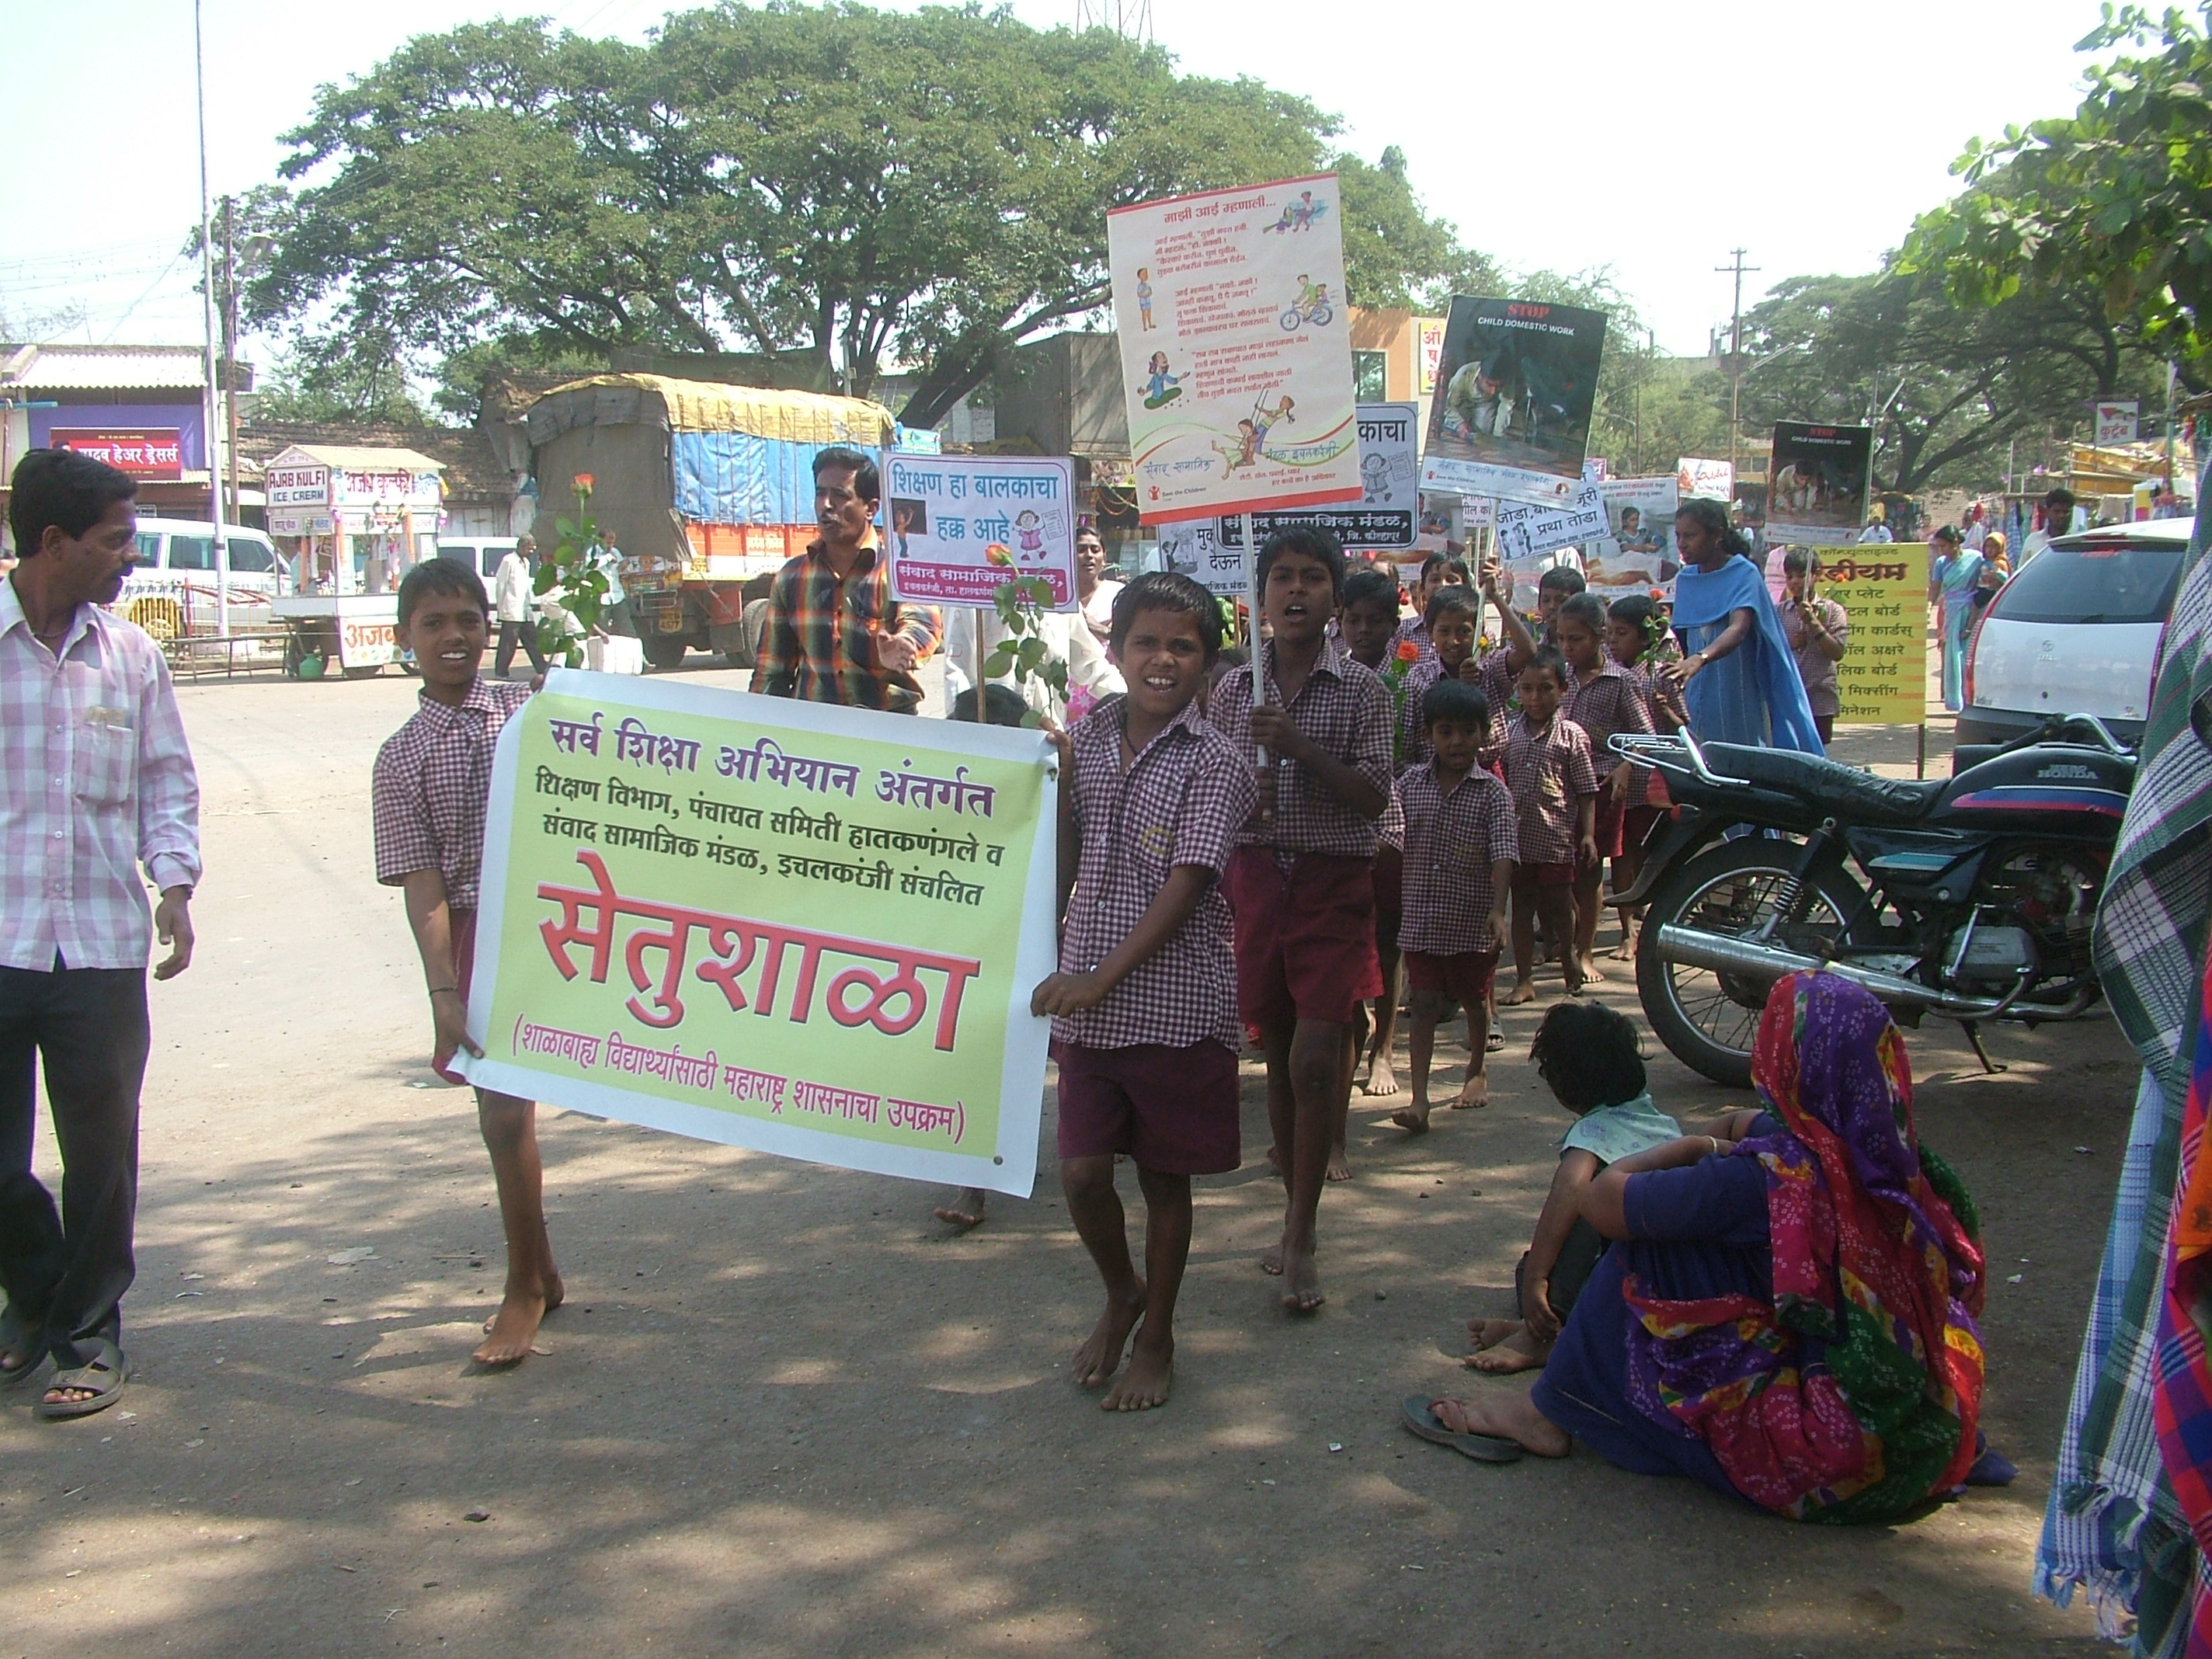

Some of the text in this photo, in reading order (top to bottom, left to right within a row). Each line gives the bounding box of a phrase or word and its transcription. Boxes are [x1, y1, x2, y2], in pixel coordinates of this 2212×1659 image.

[1164, 207, 1191, 223] माझी
[1196, 202, 1219, 217] आई
[1507, 304, 1550, 318] STOP
[1478, 317, 1575, 336] CHILD DOMESTIC WORK
[1358, 419, 1407, 443] काचा
[112, 443, 144, 464] हेअर
[144, 443, 179, 465] ड्रेसर्स
[269, 472, 294, 489] AJAB
[296, 470, 325, 487] KULFI
[892, 463, 1059, 499] शिक्षण हा बालकाचा
[293, 490, 324, 501] CREAM
[1184, 486, 1207, 495] Children
[935, 509, 1010, 544] हक्क आहे
[1224, 515, 1271, 530] संाद
[1359, 513, 1408, 529] मंडळ,
[1536, 519, 1563, 537] प्रथा
[1208, 548, 1241, 571] देऊन
[899, 564, 936, 579] संवाद
[940, 568, 1011, 584] सामाजिक
[1819, 558, 1909, 583] डीयम
[1856, 585, 1885, 600] प्लेट
[1845, 602, 1901, 617] टल बोर्ड
[1871, 623, 1914, 638] कार्डस्
[1871, 642, 1905, 656] अक्षरे
[1836, 662, 1898, 676] लिक बोर्ड
[1849, 682, 1899, 696] मिक्सींग
[1839, 702, 1881, 716] मिनेशन
[549, 711, 996, 819] सर्व शिक्षा अभियान अंतर्गत
[2037, 770, 2098, 780] HONDA
[536, 764, 1006, 867] शिक्षण विभाग, पंचायत समिती हातकणंगले व
[544, 807, 985, 906] संवाद सामाजिक मंडळ, इचलकरंजी संचलित
[537, 849, 981, 1053] सेतुशाळा
[511, 1013, 965, 1144] (शाळाबाह्य विद्यार्थ्यांसाठी महाराष्ट्र शासनाचा उपक्रम)
